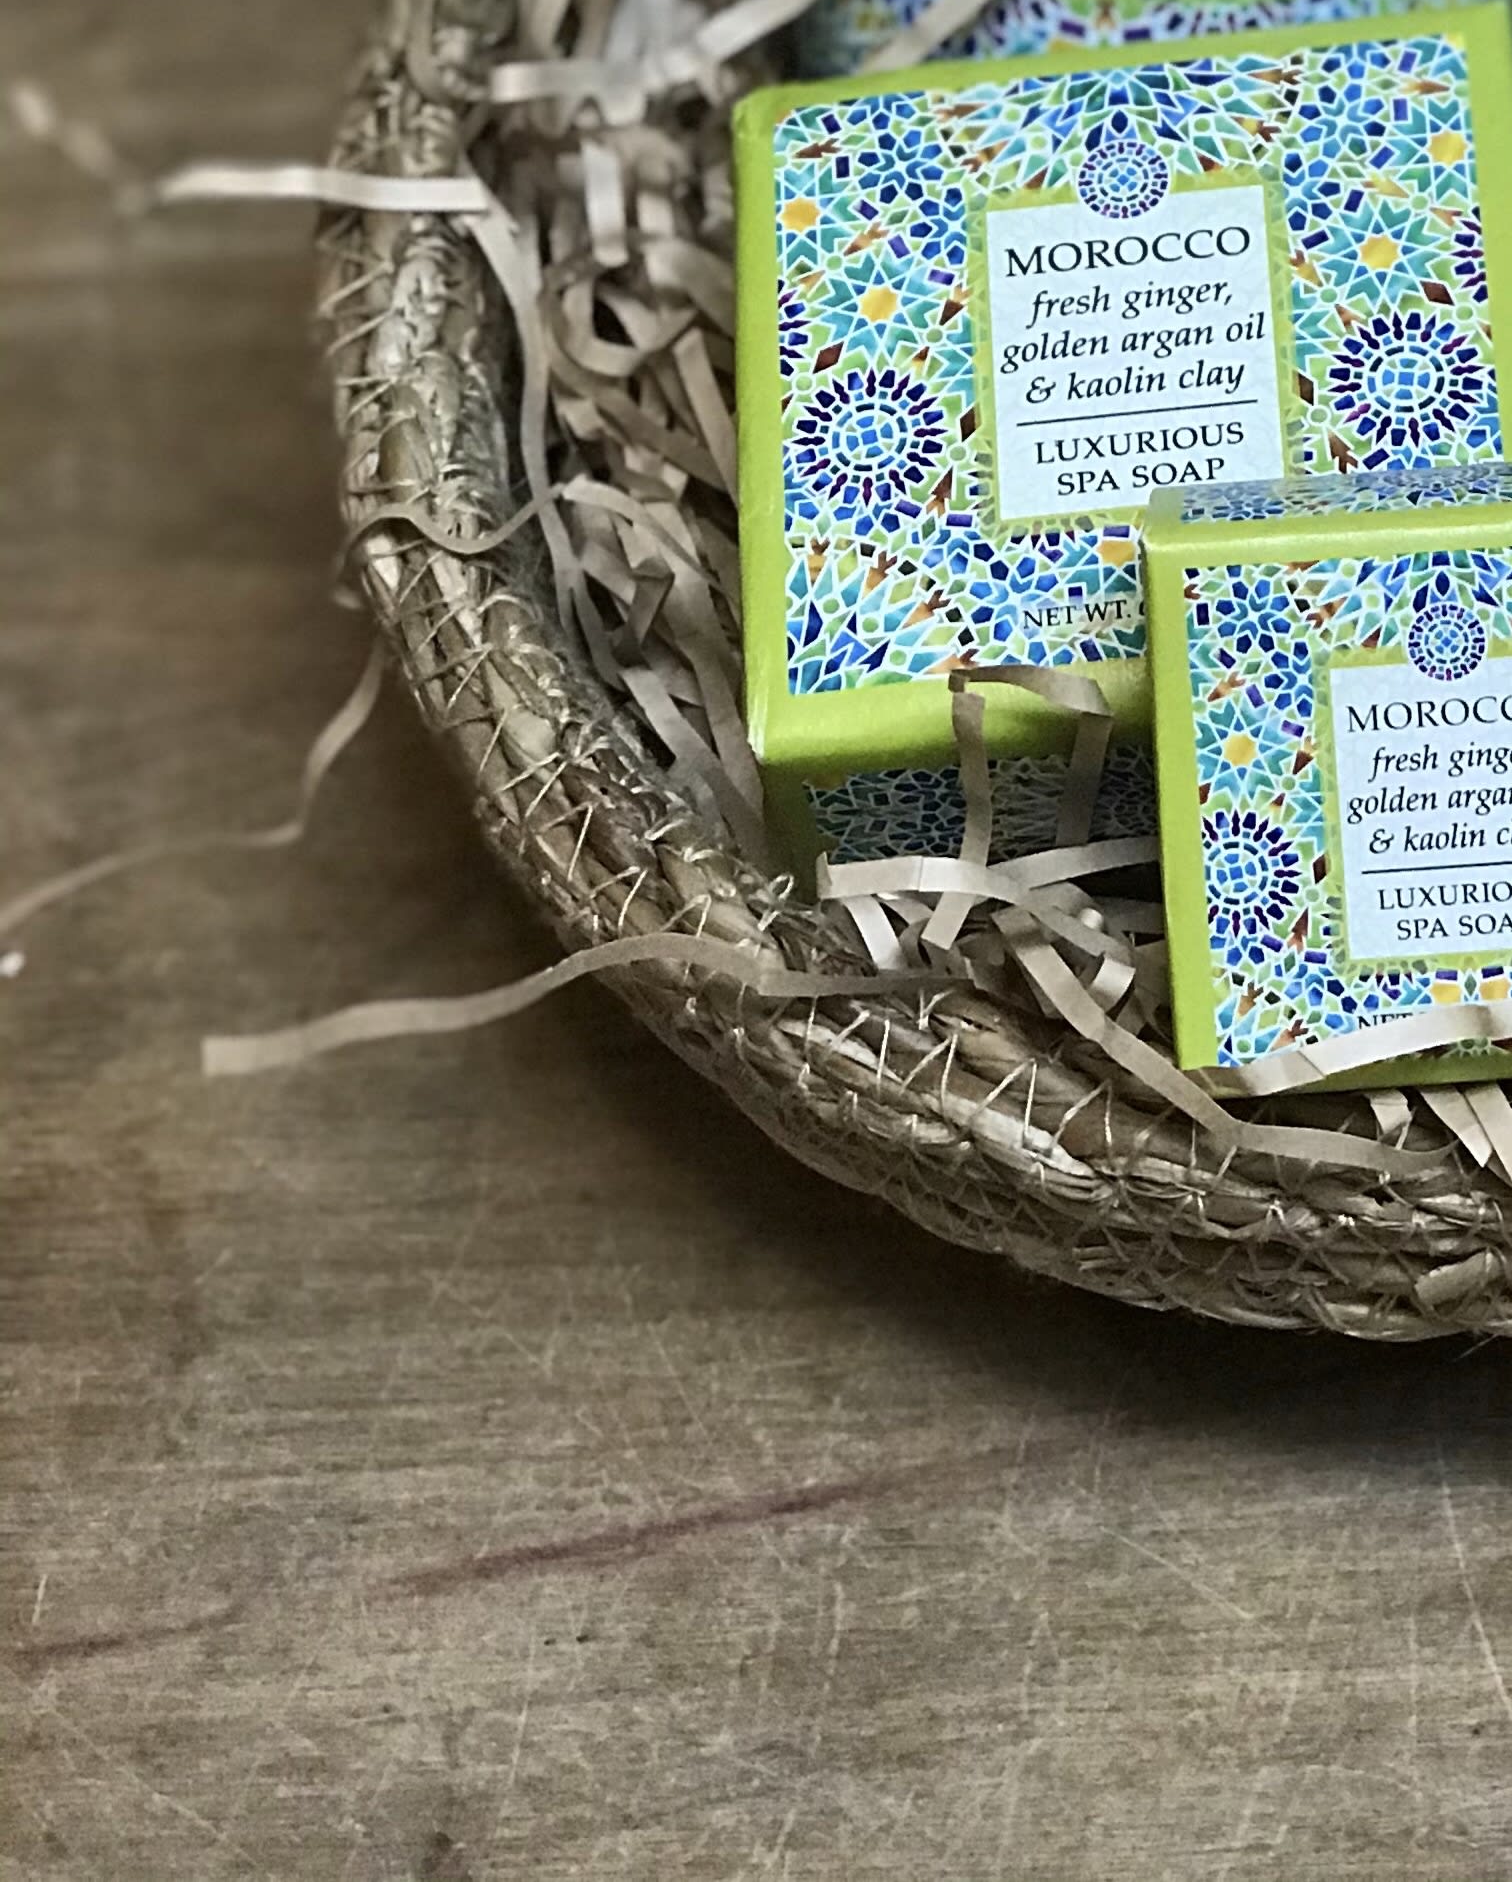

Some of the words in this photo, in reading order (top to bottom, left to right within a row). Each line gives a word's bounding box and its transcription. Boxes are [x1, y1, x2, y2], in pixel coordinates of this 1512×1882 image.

[1004, 226, 1251, 277] MOROCCO
[1026, 285, 1111, 329] fresh
[1122, 279, 1234, 319] ginger,
[1000, 329, 1110, 375] golden
[1120, 320, 1215, 360] argan
[1225, 312, 1266, 343] oil
[1025, 376, 1057, 404] &
[1067, 365, 1167, 400] kaolin
[1178, 360, 1246, 394] clay
[1034, 422, 1244, 464] LUXURIOUS
[1056, 470, 1120, 496] SPA
[1132, 457, 1226, 486] SOAP
[1023, 604, 1076, 629] NET
[1085, 599, 1131, 622] WT.
[1367, 745, 1438, 783] fresh
[1347, 787, 1438, 825] golden
[1368, 828, 1396, 854] &
[1404, 821, 1486, 852] kaolin
[1397, 917, 1447, 941] SPA
